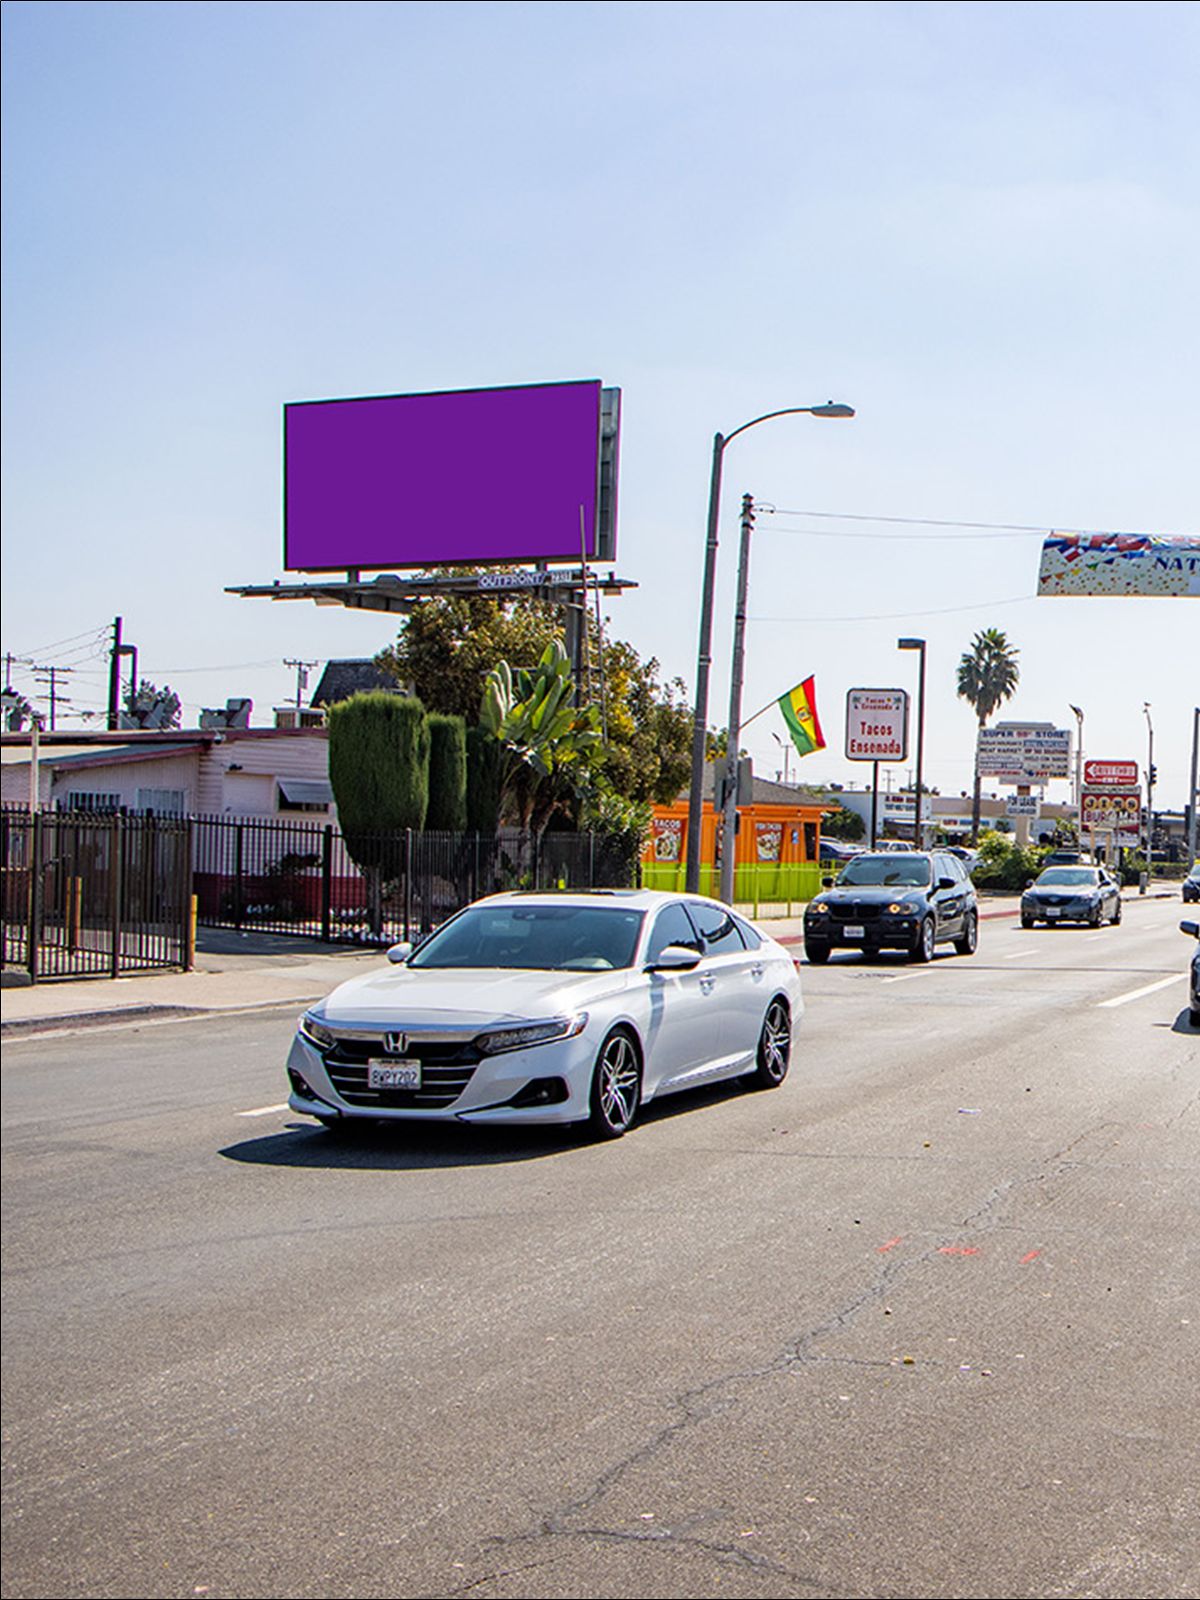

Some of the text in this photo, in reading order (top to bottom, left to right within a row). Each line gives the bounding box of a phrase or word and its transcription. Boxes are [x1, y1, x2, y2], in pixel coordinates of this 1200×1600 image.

[861, 721, 893, 736] Tacos
[982, 730, 1014, 738] SUPER
[850, 739, 901, 754] Ensenada
[653, 819, 680, 828] TACOS
